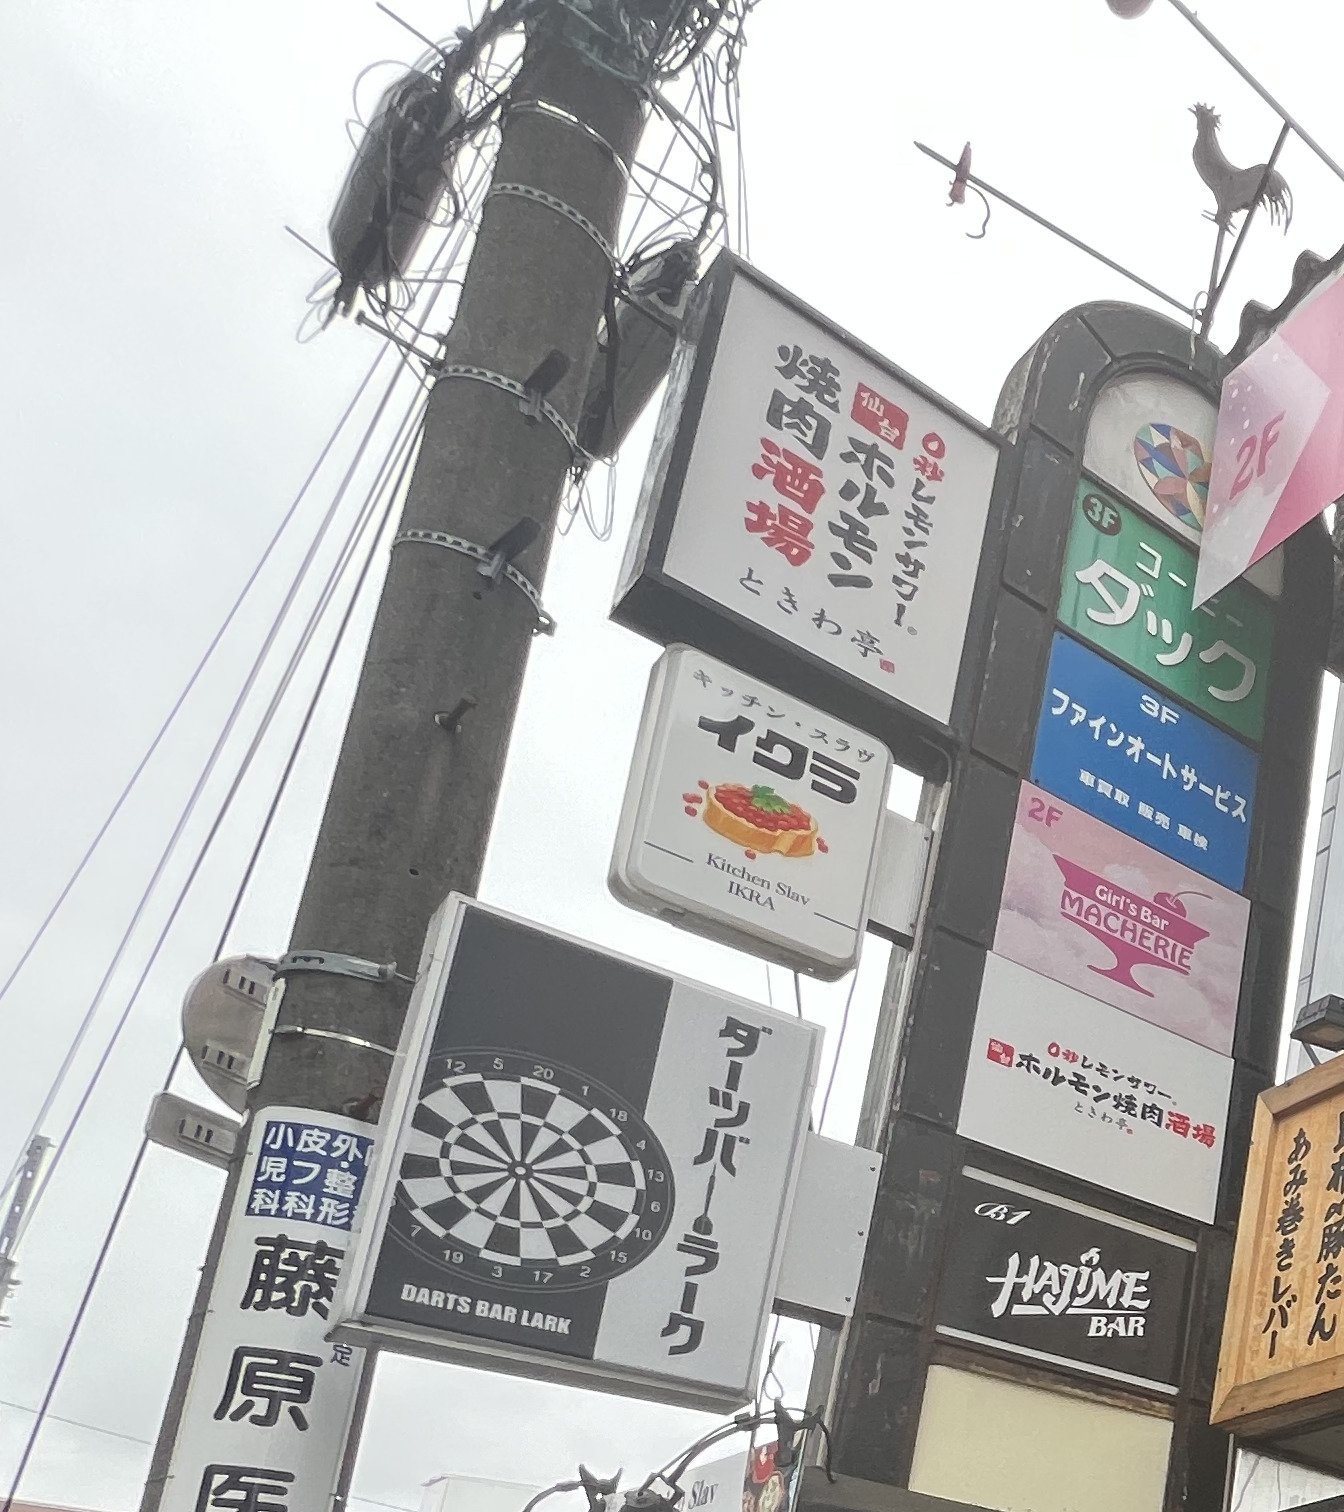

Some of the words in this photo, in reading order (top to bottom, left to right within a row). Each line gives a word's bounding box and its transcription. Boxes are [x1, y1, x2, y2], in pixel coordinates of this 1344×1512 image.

[745, 344, 842, 567] 焼肉酒場
[1228, 410, 1286, 503] 2F
[828, 436, 895, 589] ホルモン
[1086, 498, 1119, 528] 3F
[739, 567, 883, 657] ときわ亭
[1075, 558, 1257, 702] ダック
[1139, 694, 1181, 725] 3F
[698, 715, 861, 805] イクラ
[1051, 688, 1248, 823] ファインオートサービス
[1027, 797, 1064, 829] 2F
[706, 853, 771, 890] Kitchen
[775, 881, 810, 906] Slav
[728, 880, 775, 911] IKRA
[1094, 883, 1138, 924] Girl's
[1139, 904, 1169, 931] Bar
[1061, 889, 1192, 971] MACHERIE
[446, 1058, 467, 1073] 12
[493, 1058, 504, 1071] 5
[533, 1065, 554, 1080] 20
[582, 1085, 589, 1097] 1
[609, 1108, 628, 1122] 18
[636, 1139, 646, 1150] 4
[648, 1169, 664, 1183] 13
[650, 1200, 660, 1213] 6
[974, 1201, 1032, 1225] B1
[410, 1225, 422, 1237] 7
[634, 1227, 652, 1241] 10
[442, 1249, 464, 1264] 19
[609, 1250, 628, 1264] 15
[492, 1266, 503, 1279] 3
[533, 1270, 553, 1284] 17
[580, 1266, 591, 1279] 2
[401, 1283, 471, 1313] DARTS
[475, 1300, 517, 1325] BAR
[520, 1311, 572, 1335] LARK
[1087, 1316, 1145, 1338] BAR
